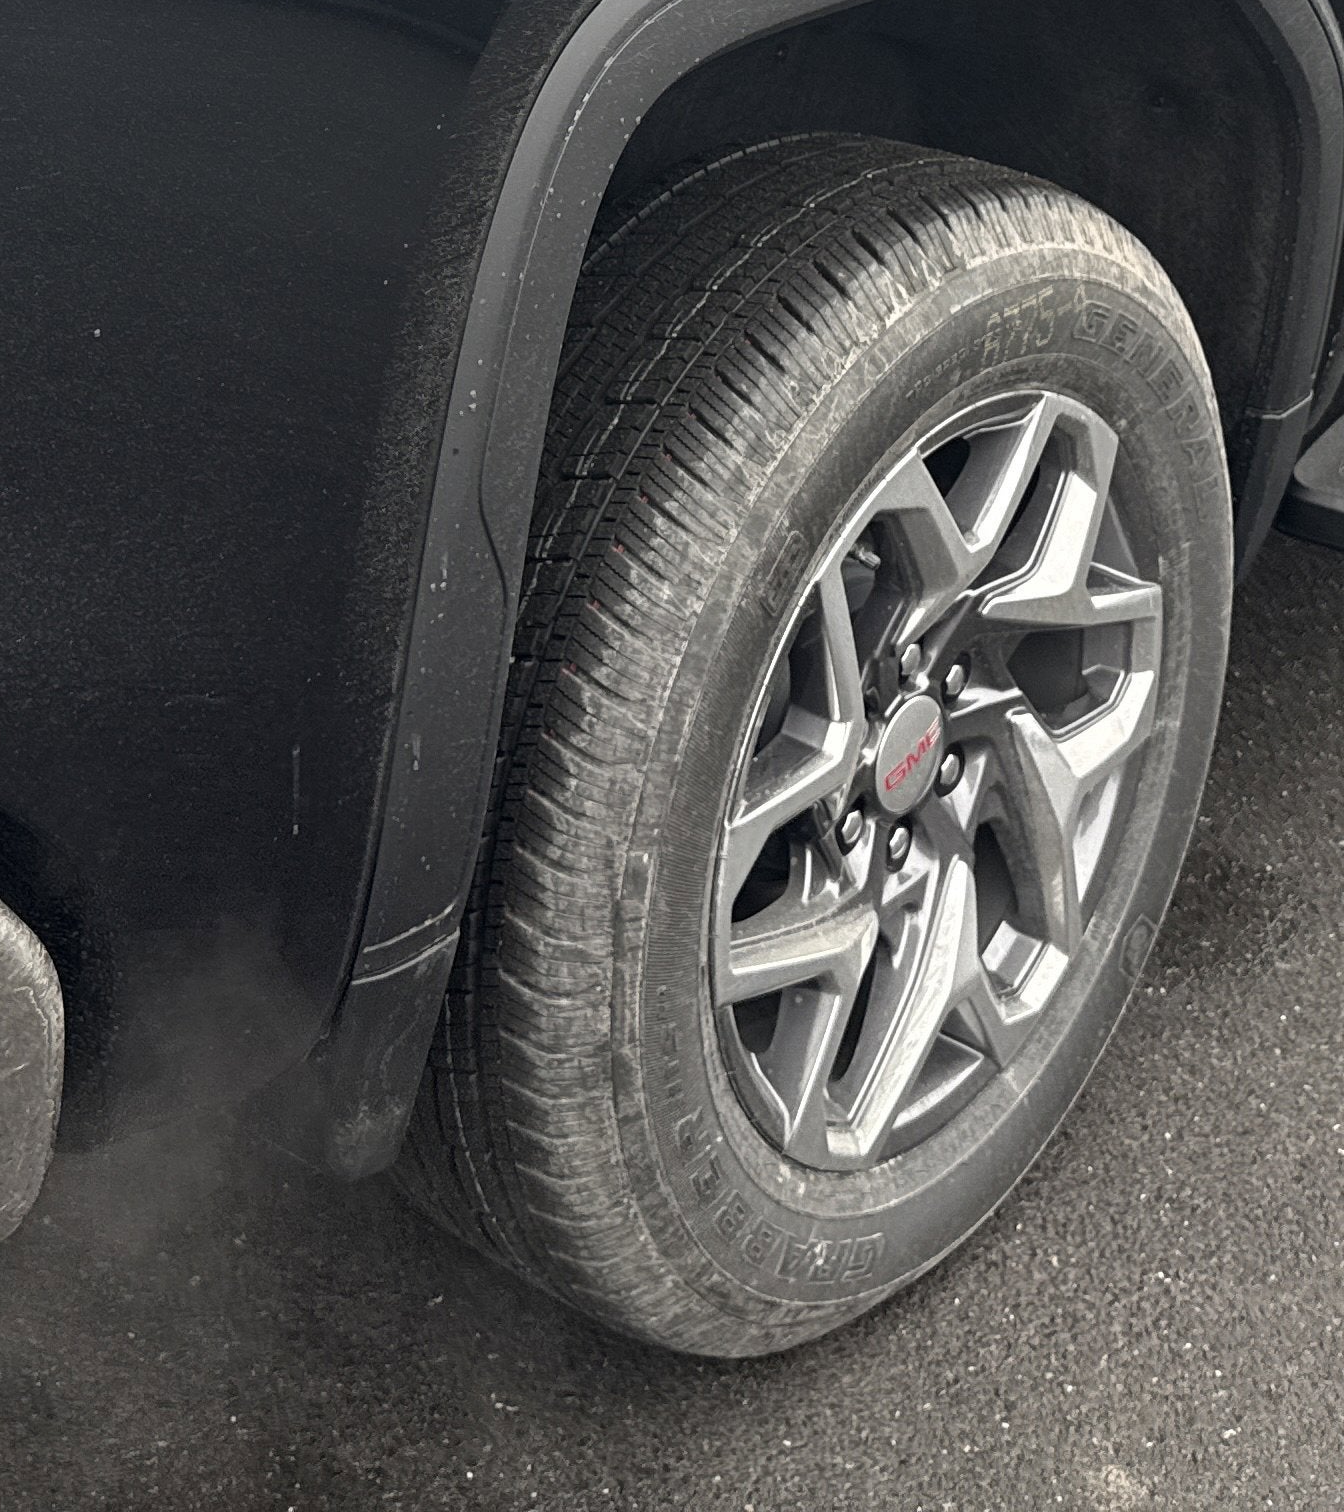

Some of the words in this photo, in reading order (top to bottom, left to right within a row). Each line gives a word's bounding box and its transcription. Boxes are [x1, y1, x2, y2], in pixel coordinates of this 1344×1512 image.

[1072, 299, 1221, 496] GENERAL
[884, 716, 942, 792] GMC
[675, 1105, 887, 1285] GRABBER
